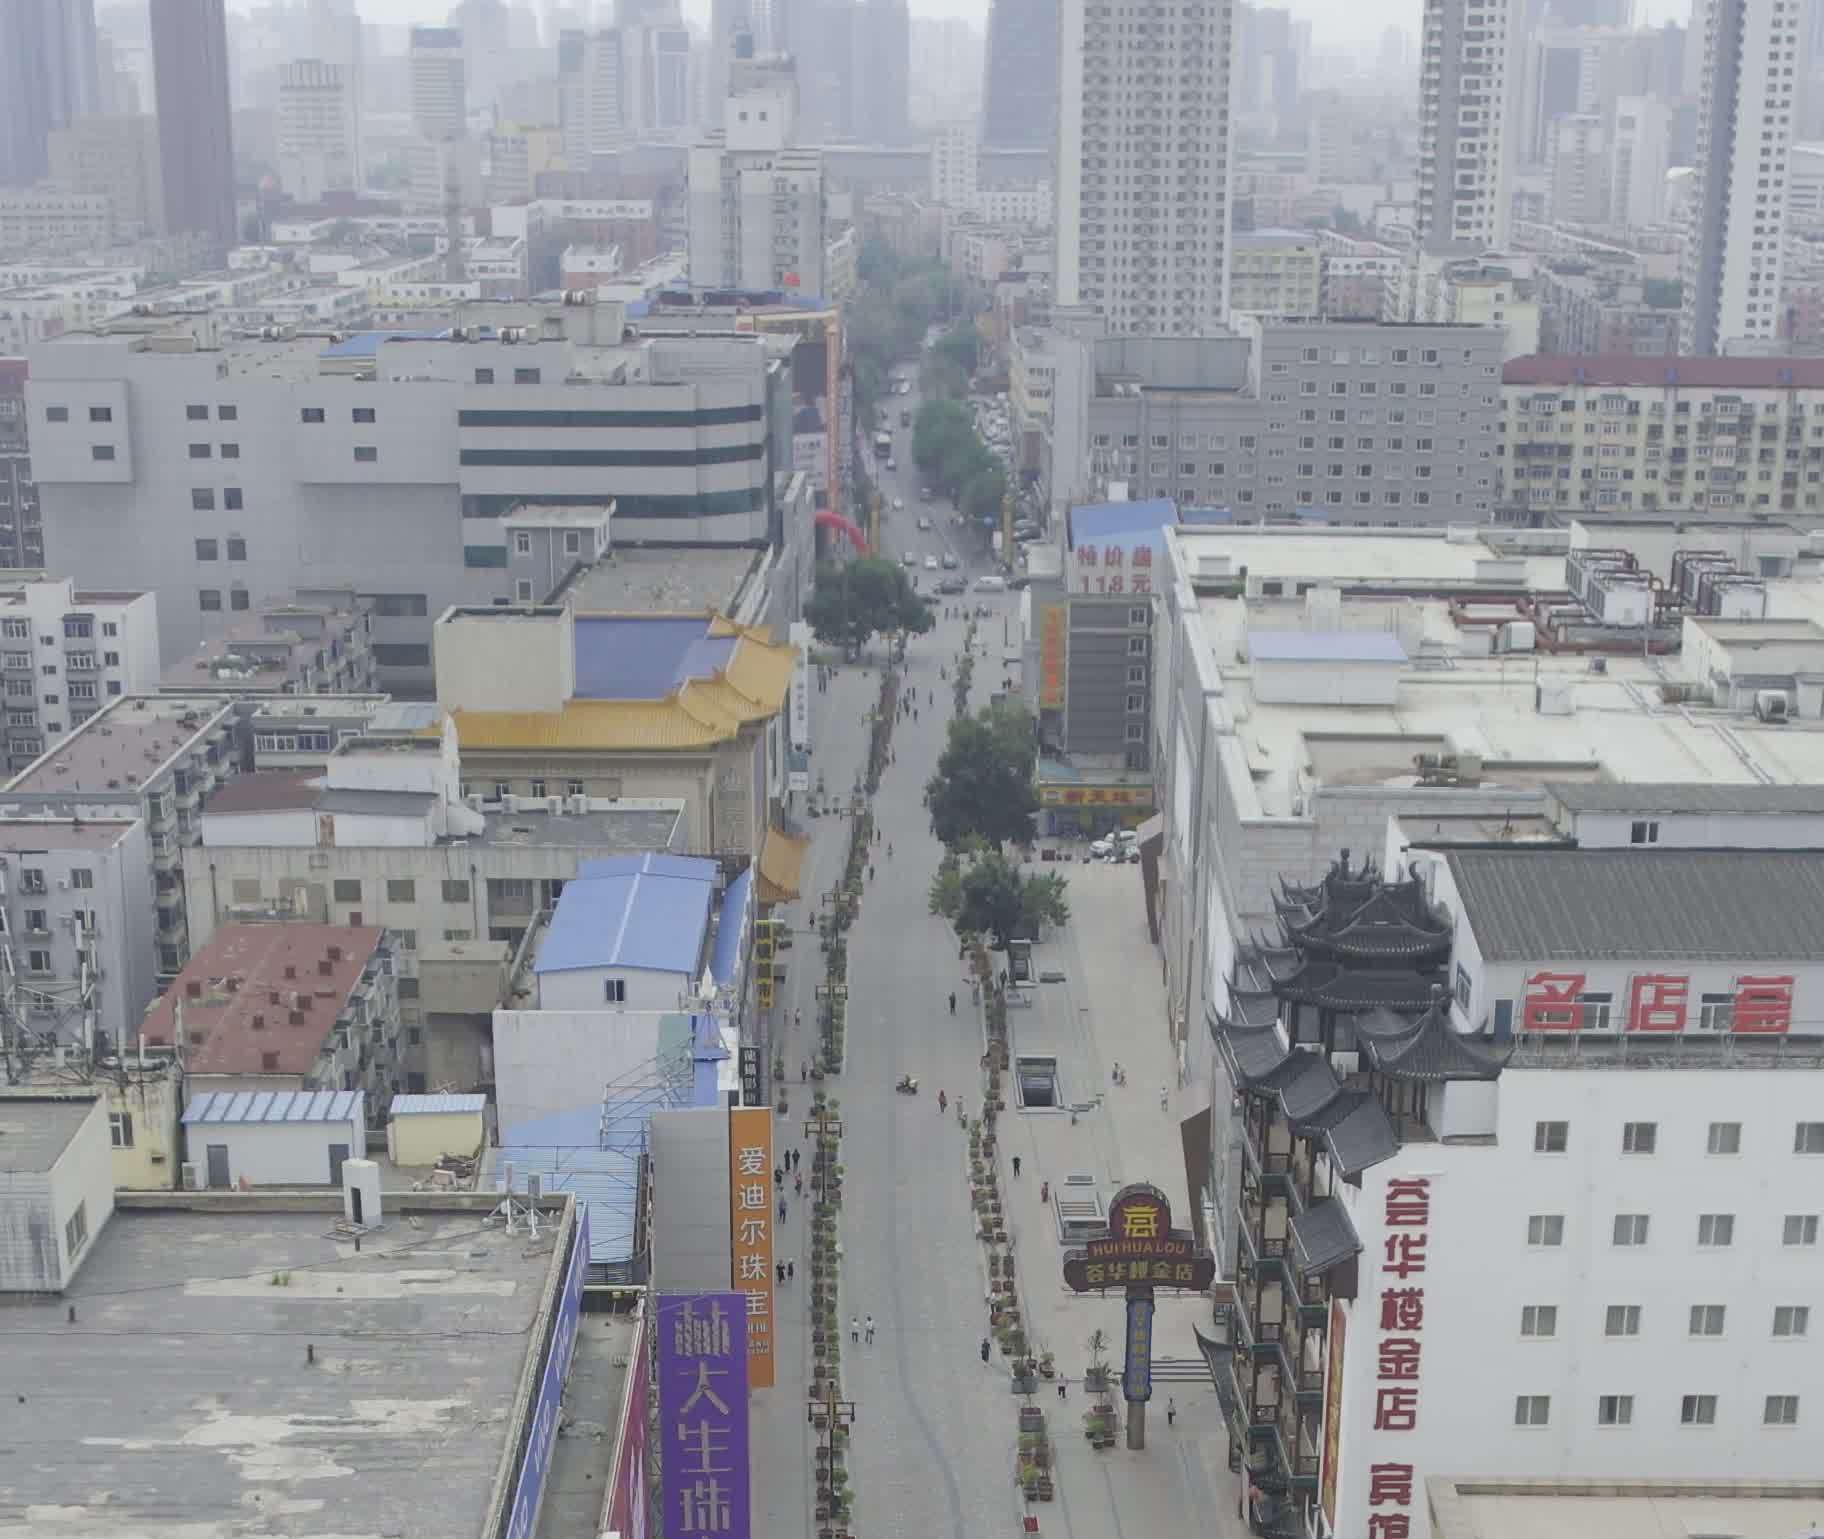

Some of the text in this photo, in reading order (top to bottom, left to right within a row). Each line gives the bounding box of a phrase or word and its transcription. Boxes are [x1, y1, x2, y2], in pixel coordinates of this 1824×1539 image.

[738, 1146, 770, 1317] 爱迪尔珠宝
[1374, 1177, 1430, 1432] 荟华楼金店
